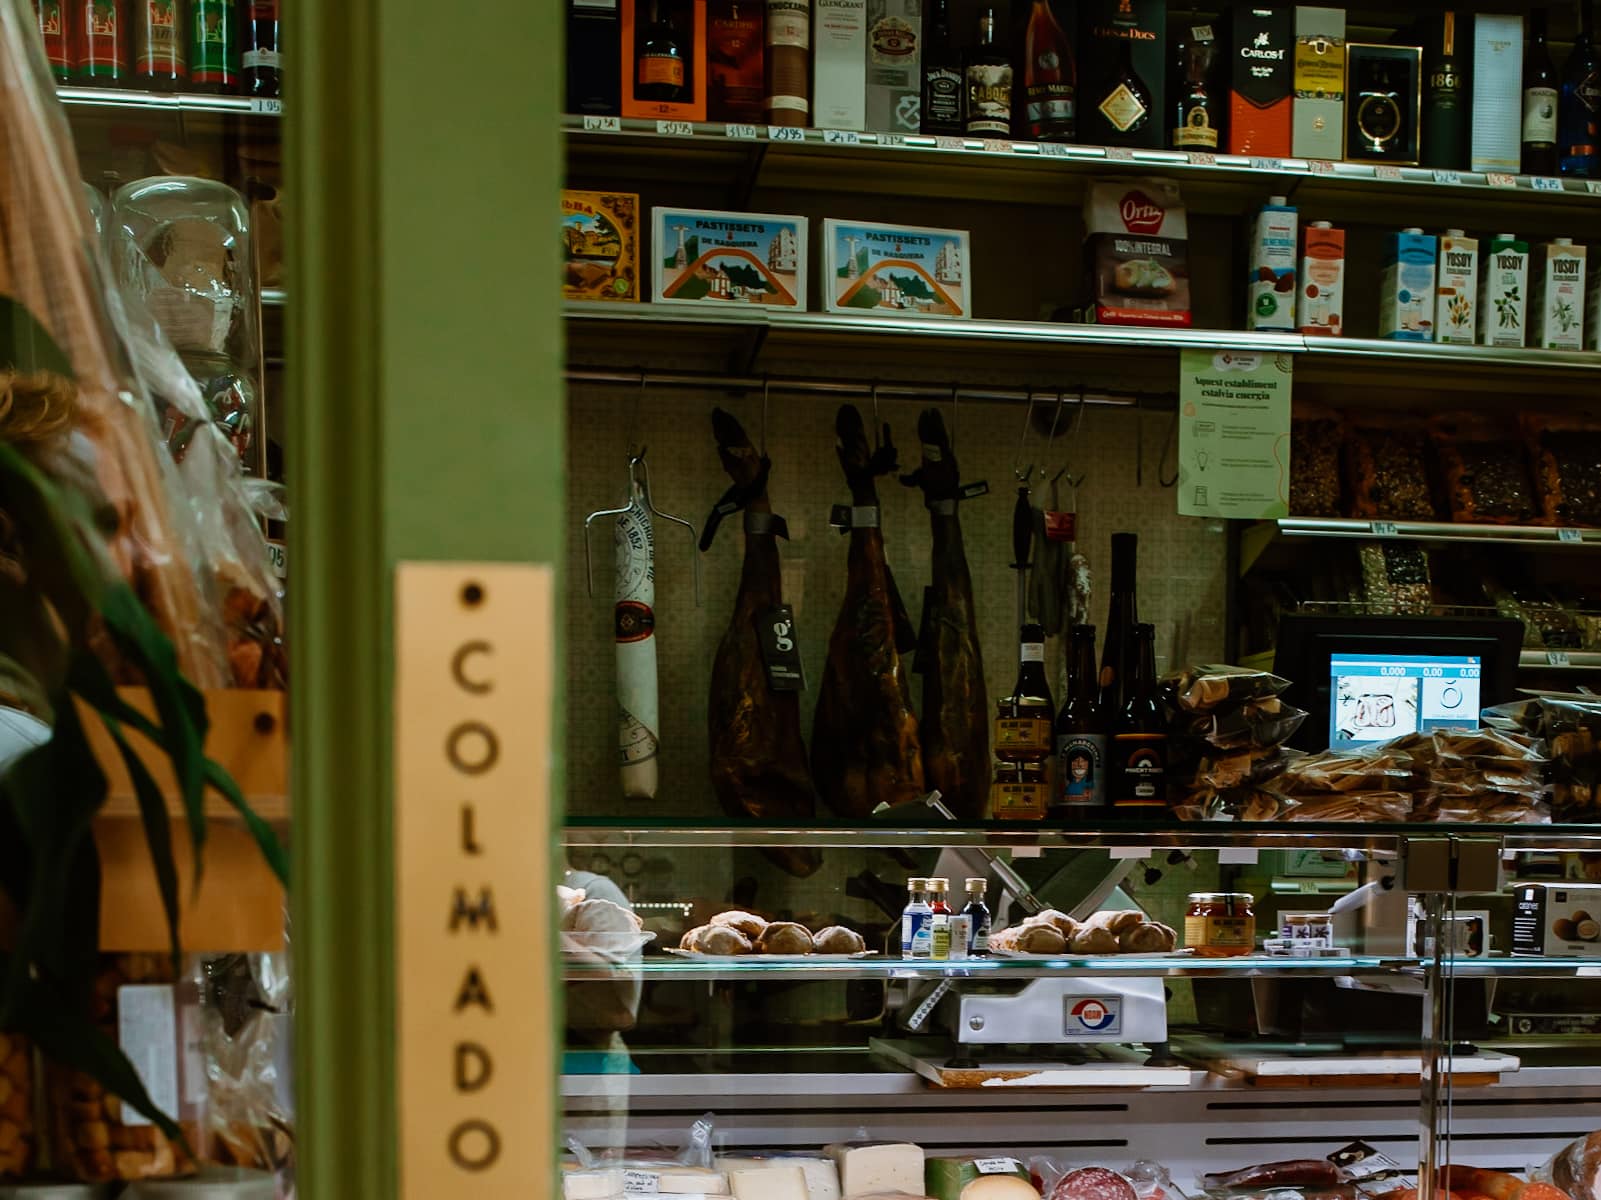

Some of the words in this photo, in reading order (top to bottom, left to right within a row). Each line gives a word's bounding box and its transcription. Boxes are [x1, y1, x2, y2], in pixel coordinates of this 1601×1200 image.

[696, 220, 765, 234] PASTISSETS
[865, 232, 931, 246] PASTISSETS
[1446, 252, 1472, 268] YOSOY
[1497, 255, 1523, 271] YOSOY
[1553, 260, 1581, 274] YOSOY
[1194, 376, 1223, 388] Aquest
[1224, 379, 1277, 390] establiment
[1201, 389, 1235, 399] estalvia
[1235, 391, 1270, 401] energia
[626, 527, 643, 550] 1852
[1423, 668, 1443, 678] 0.00
[1460, 669, 1480, 678] 0.00
[445, 641, 501, 1172] COLMADO
